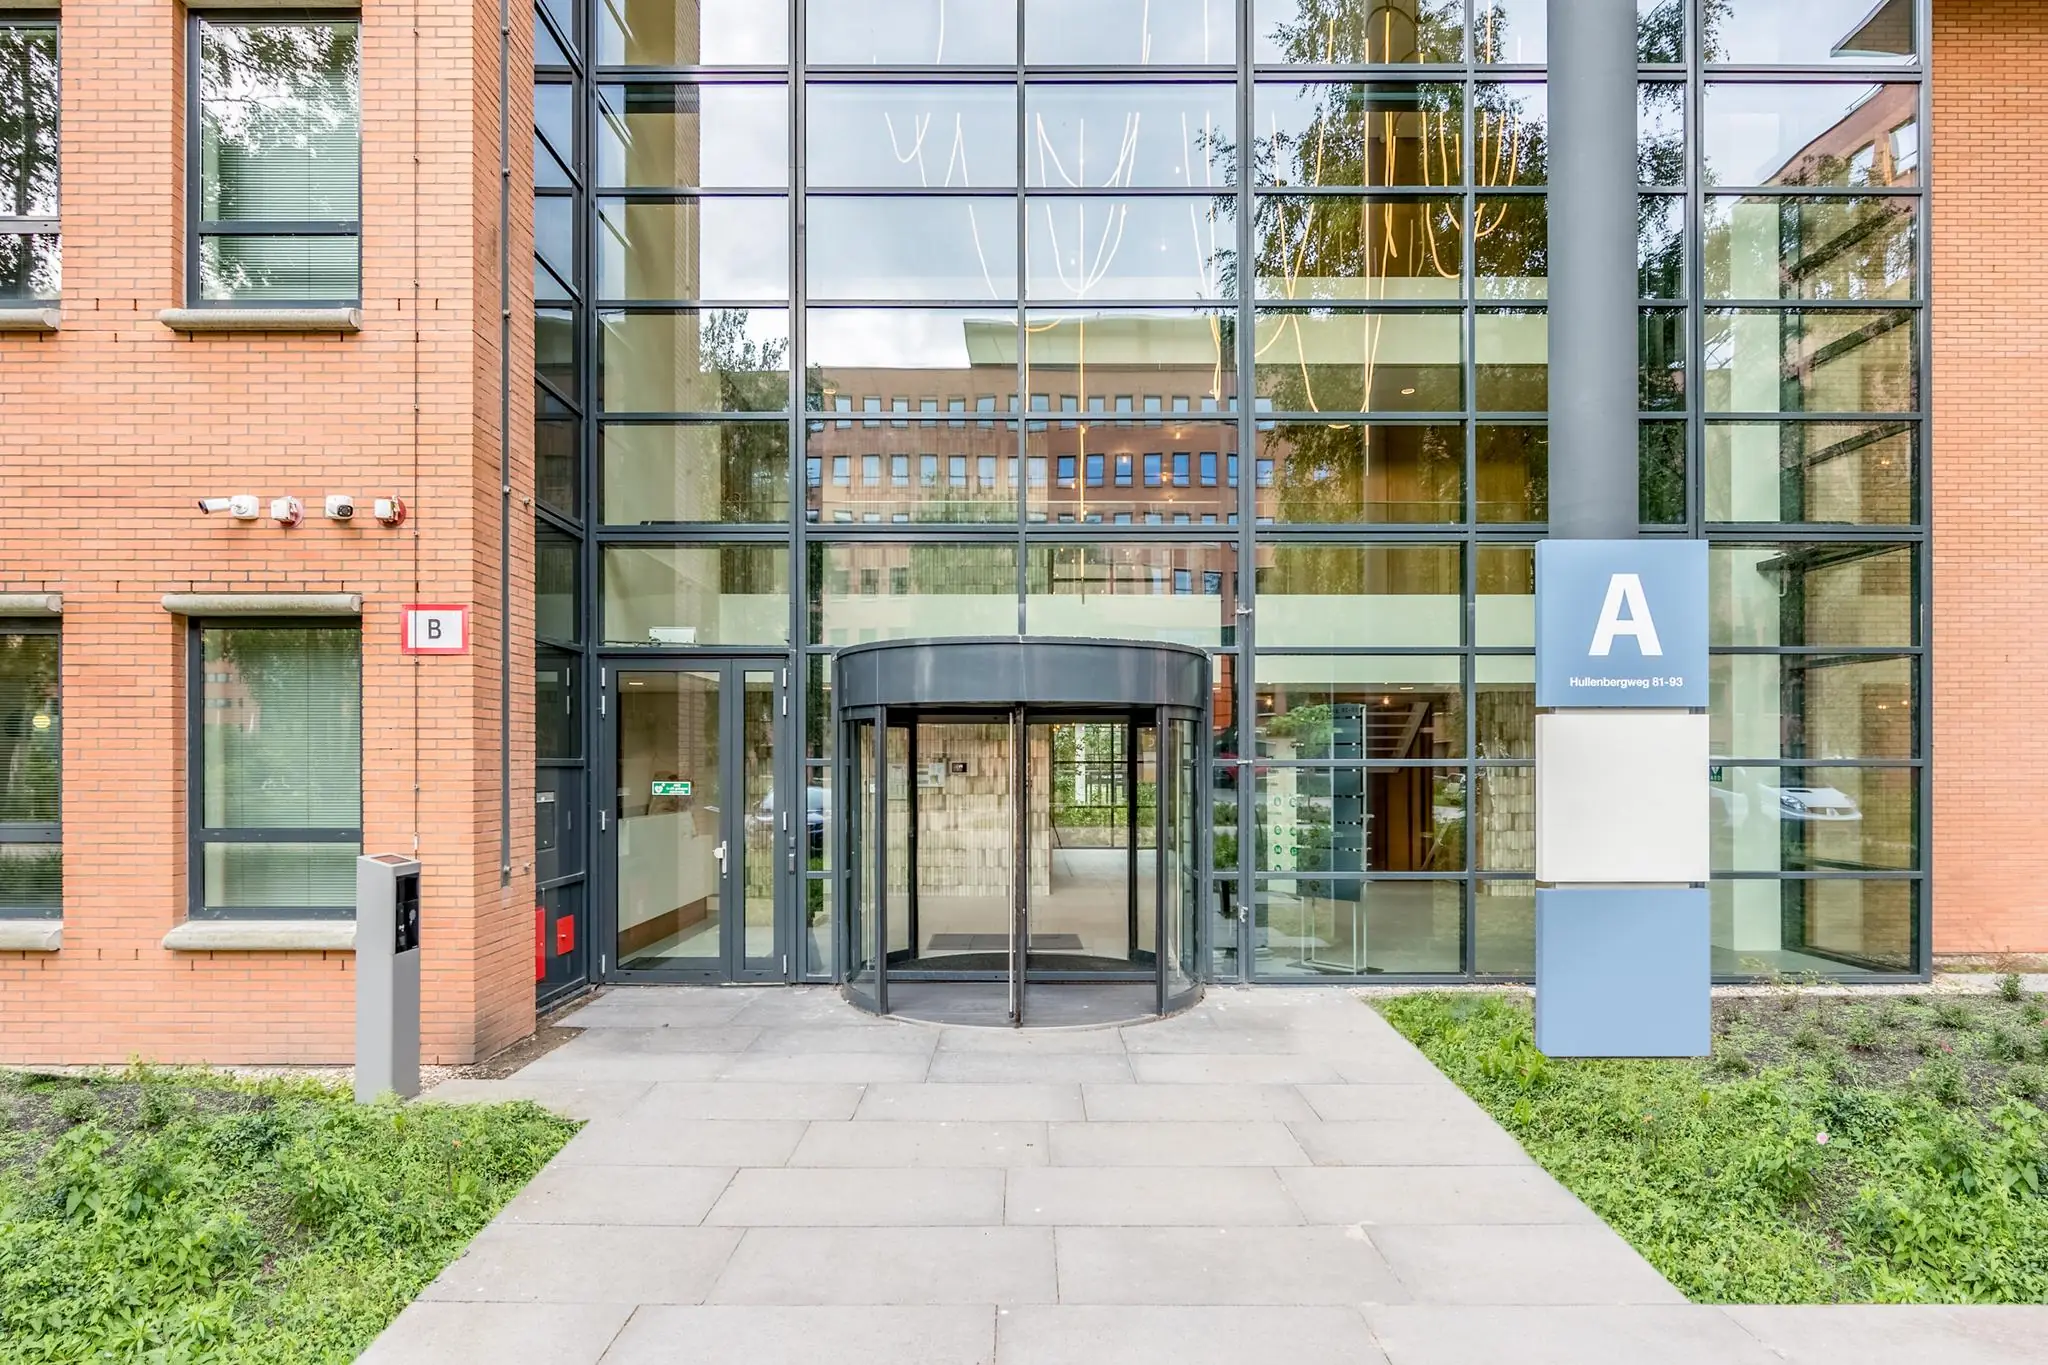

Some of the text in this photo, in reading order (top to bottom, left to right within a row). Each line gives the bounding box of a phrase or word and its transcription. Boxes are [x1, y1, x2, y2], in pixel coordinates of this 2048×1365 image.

[1588, 573, 1663, 656] A
[428, 618, 442, 639] B
[1569, 676, 1684, 689] Hullenbergweg 81-93
